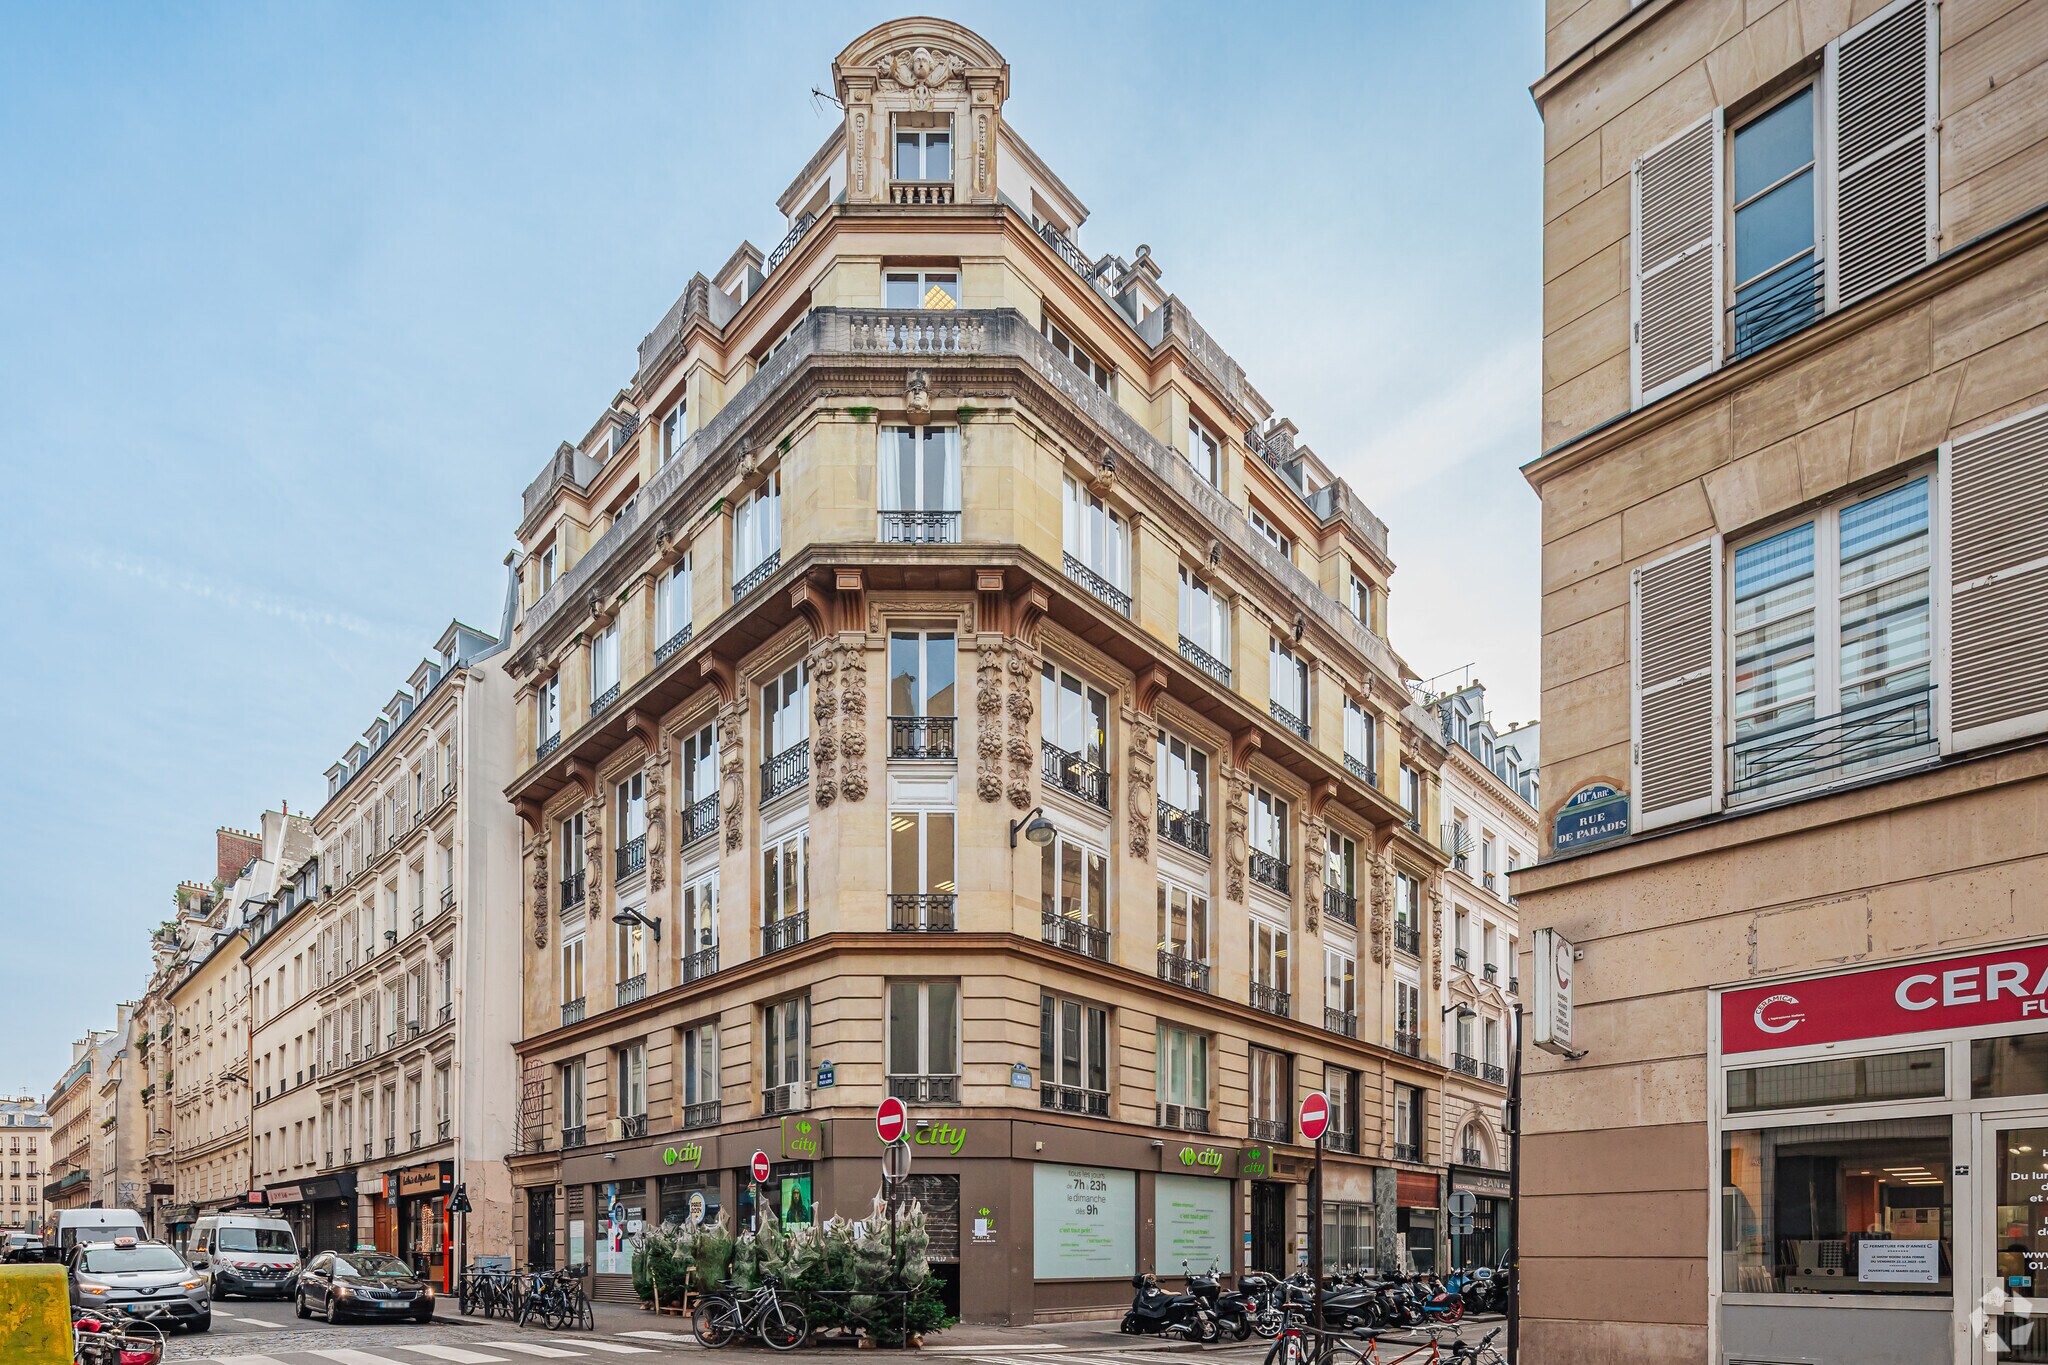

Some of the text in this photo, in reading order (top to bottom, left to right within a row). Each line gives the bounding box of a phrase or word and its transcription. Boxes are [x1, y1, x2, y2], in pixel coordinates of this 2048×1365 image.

[1580, 812, 1606, 826] RUE
[1558, 820, 1626, 844] DE PARADIS
[1756, 995, 1792, 1014] CERAMICA
[915, 1122, 966, 1155] city
[792, 1138, 816, 1157] city
[678, 1142, 702, 1168] city
[1198, 1148, 1223, 1174] city
[1244, 1162, 1264, 1177] city
[2011, 1172, 2029, 1180] Du
[1073, 1179, 1085, 1190] 7h
[1090, 1180, 1106, 1191] 23h
[1477, 1177, 1500, 1188] JEAN
[1073, 1193, 1106, 1203] dimanche
[1086, 1204, 1098, 1215] 9h
[2029, 1262, 2048, 1270] 01.
